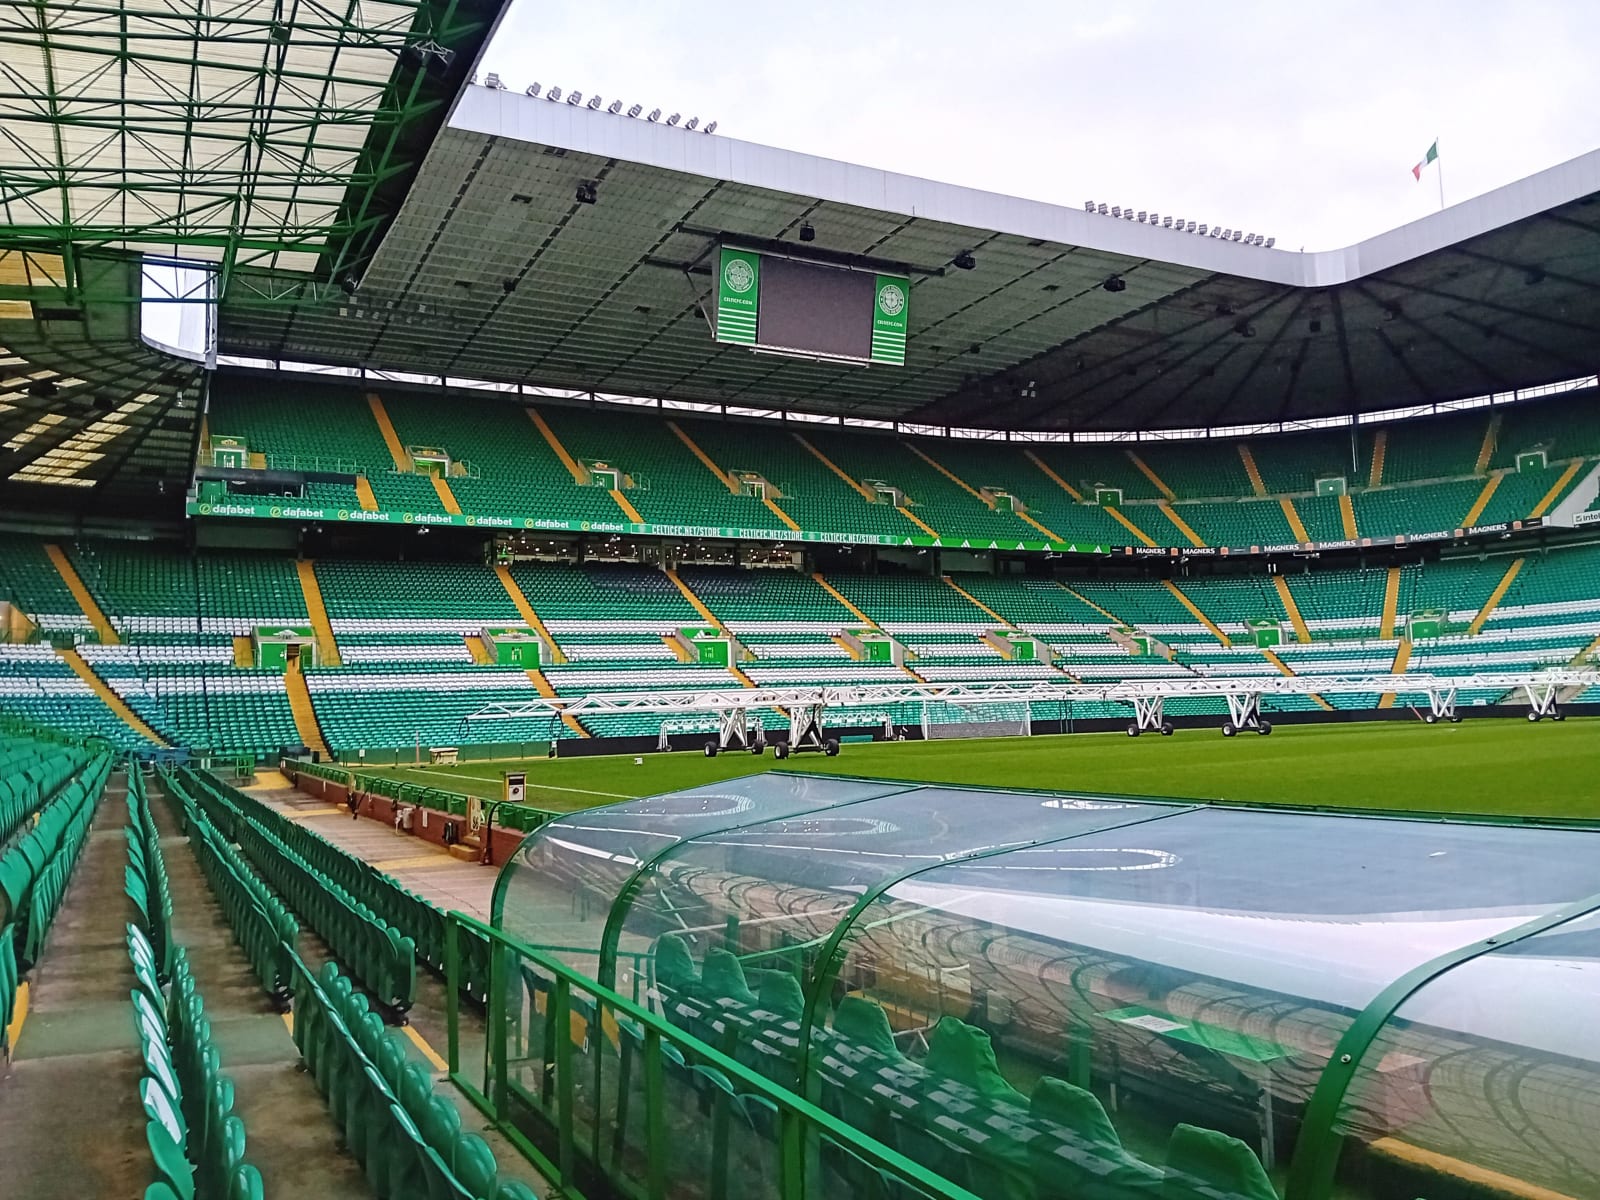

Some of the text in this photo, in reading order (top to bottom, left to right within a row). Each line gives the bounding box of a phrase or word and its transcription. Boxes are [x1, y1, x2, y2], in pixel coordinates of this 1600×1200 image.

[212, 504, 255, 515] dafabet
[283, 507, 324, 518] dafabet
[350, 510, 389, 521] dafabet
[415, 513, 452, 523] dafabet
[477, 516, 512, 526] dafabet
[535, 519, 570, 529] dafabet
[591, 521, 624, 532] dafabet
